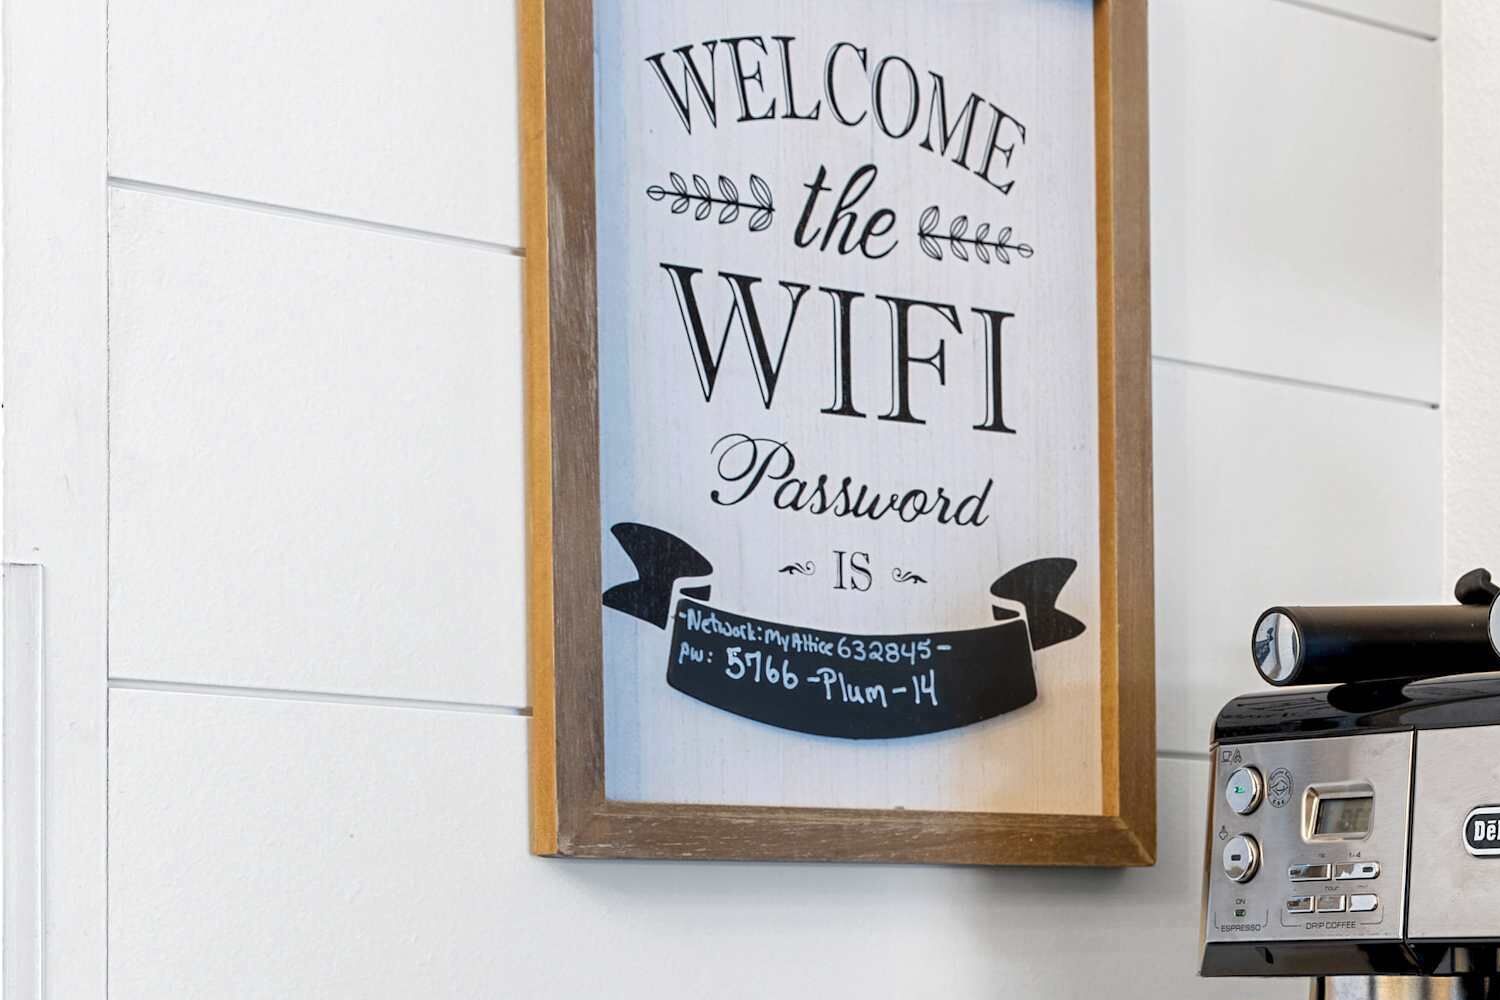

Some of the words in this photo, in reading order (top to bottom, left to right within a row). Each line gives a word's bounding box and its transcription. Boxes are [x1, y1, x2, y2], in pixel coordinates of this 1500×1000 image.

[644, 35, 1027, 195] WELCOME
[793, 163, 899, 259] the
[659, 262, 1017, 434] WIFI
[710, 432, 994, 527] Password
[832, 550, 873, 592] IS
[1220, 924, 1262, 932] ESPRESSO
[1305, 922, 1326, 930] DRIP
[1326, 921, 1357, 929] COFFEE
